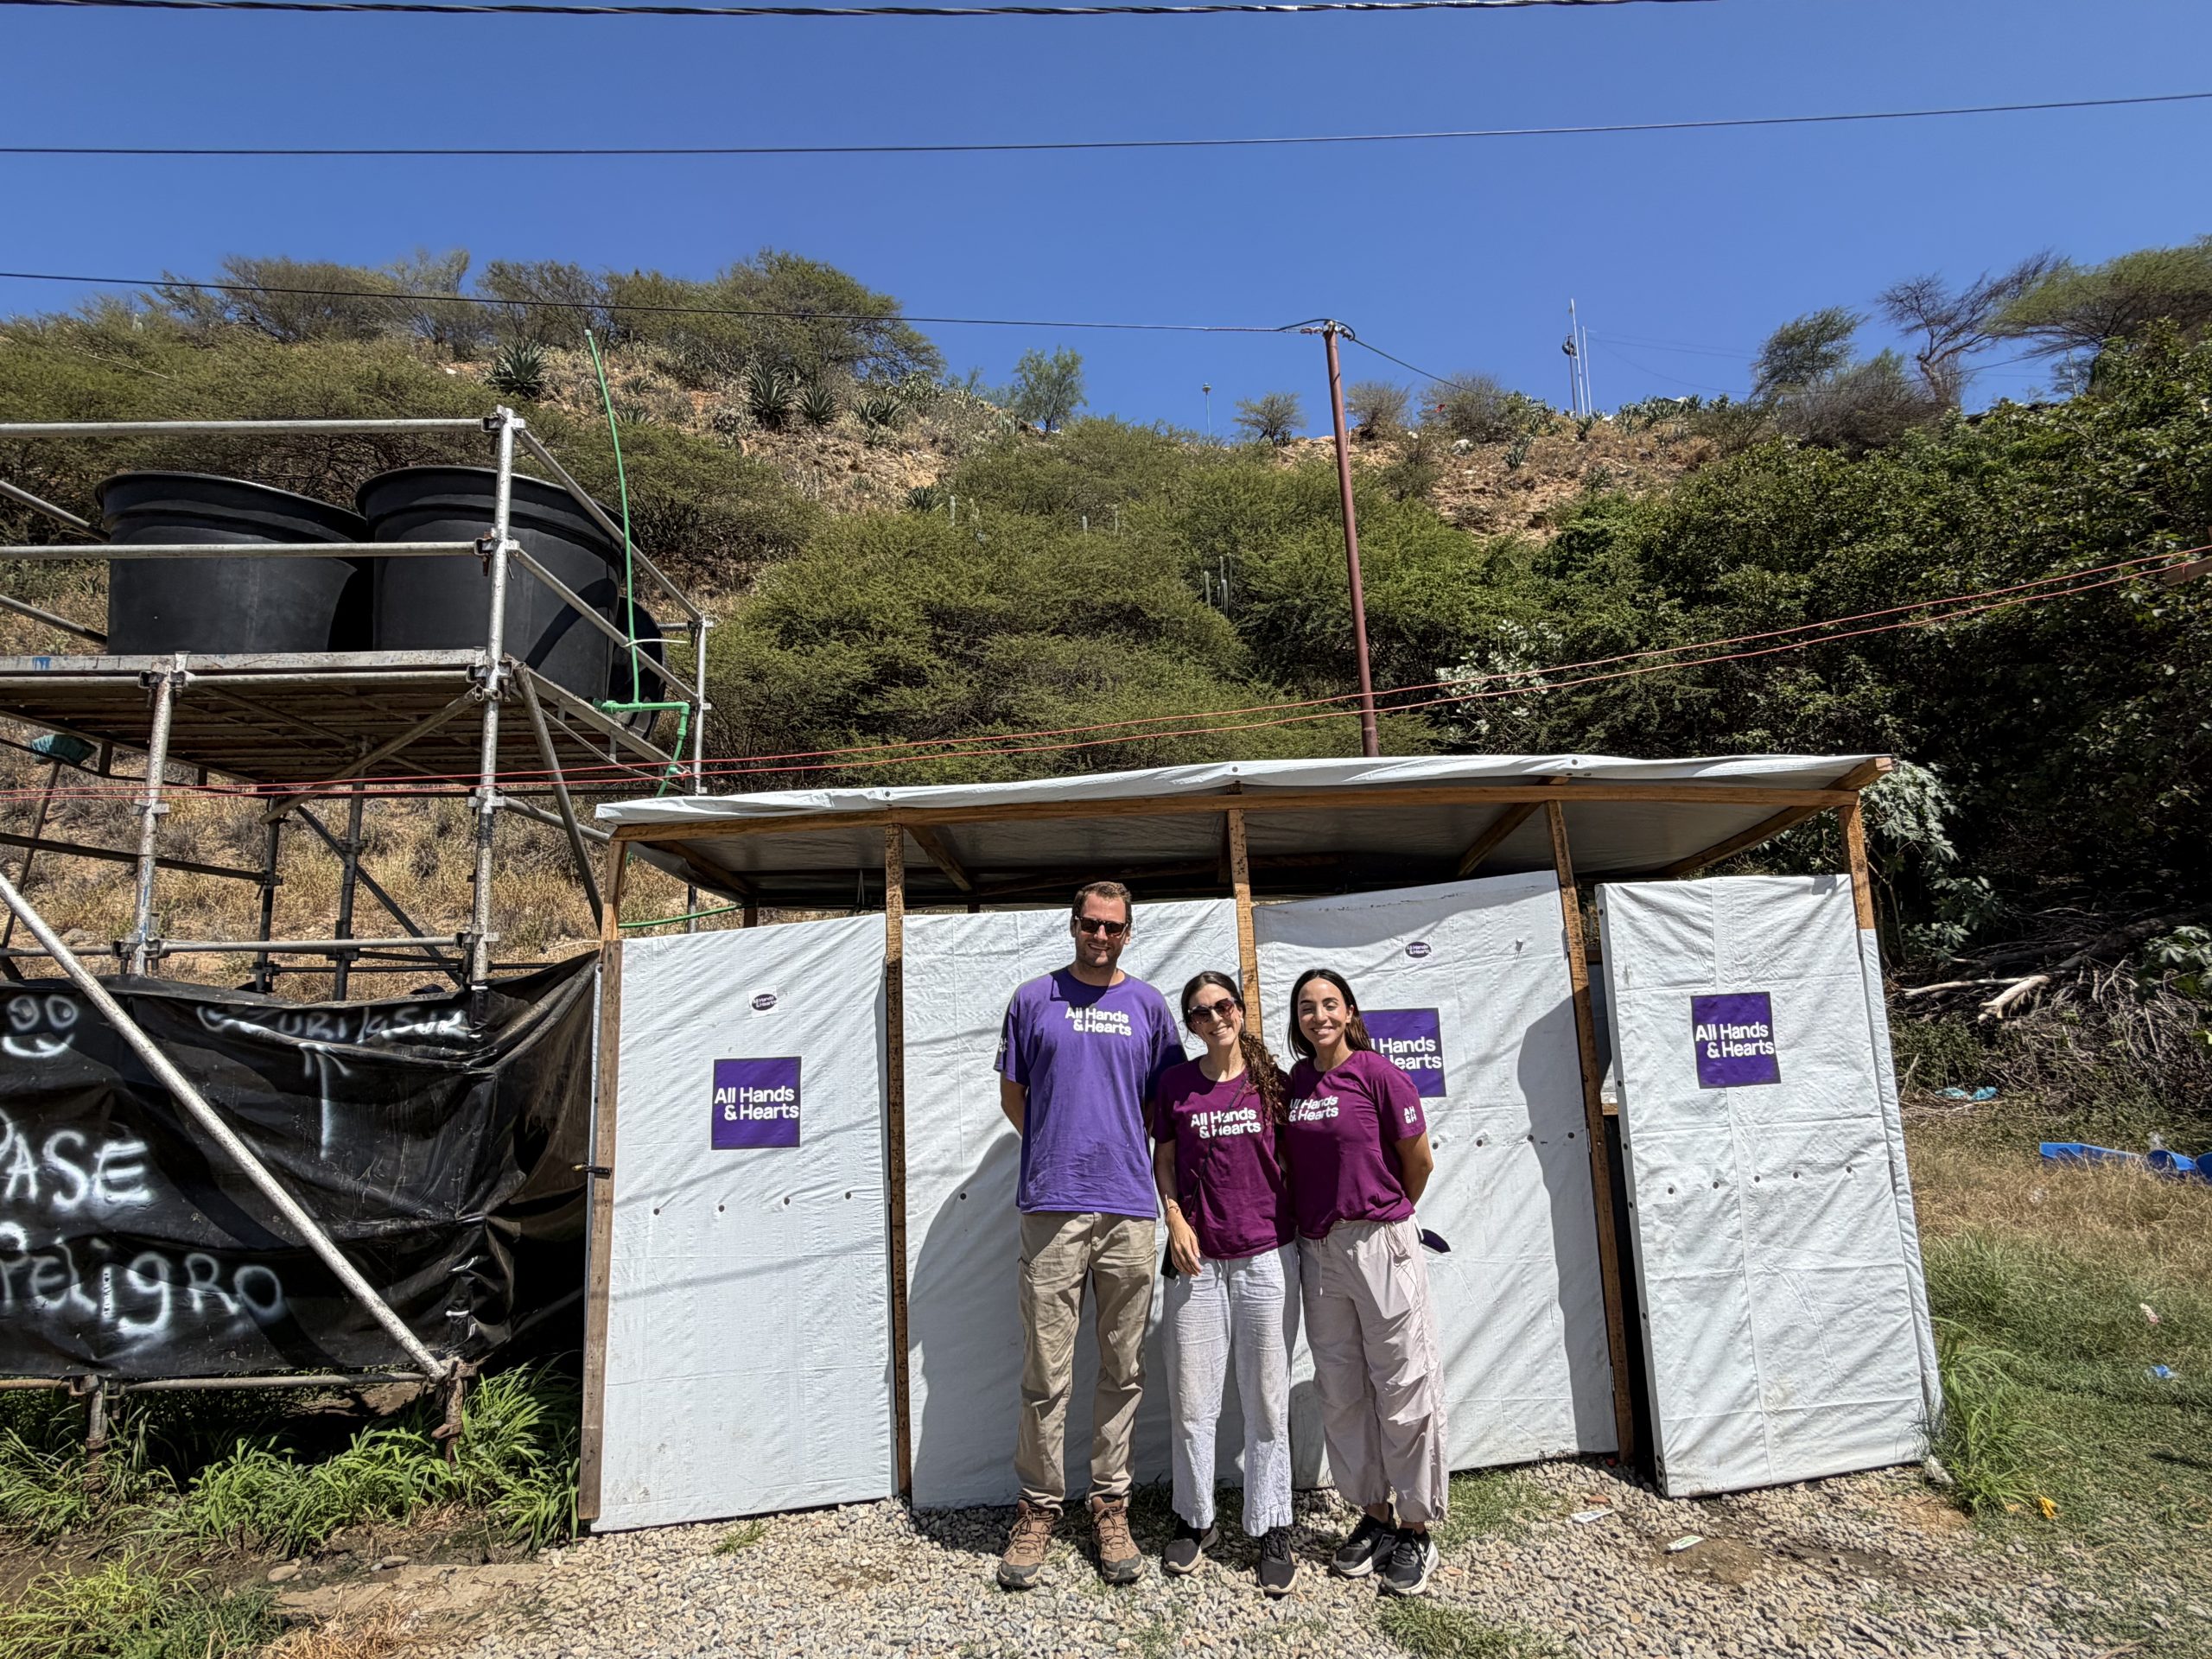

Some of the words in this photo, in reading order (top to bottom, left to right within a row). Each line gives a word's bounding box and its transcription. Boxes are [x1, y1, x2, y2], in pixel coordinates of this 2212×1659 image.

[1065, 1007, 1084, 1020] All
[1084, 1007, 1129, 1024] Hands
[1072, 1019, 1084, 1032] &
[1084, 1020, 1133, 1037] Hearts
[1695, 1023, 1718, 1042] All
[1719, 1020, 1770, 1040] Hands
[1378, 1035, 1437, 1054] Hands
[1707, 1041, 1721, 1059] &
[1721, 1039, 1776, 1058] Hearts
[714, 1086, 737, 1104] All
[739, 1084, 796, 1103] Hands
[1300, 1095, 1339, 1110] Hands
[723, 1103, 739, 1122] &
[739, 1103, 800, 1121] Hearts
[1190, 1111, 1209, 1128] All
[1210, 1107, 1258, 1124] Hands
[1288, 1109, 1297, 1123] &
[1297, 1106, 1340, 1122] Hearts
[1198, 1125, 1211, 1140] &
[1211, 1120, 1262, 1137] Hearts
